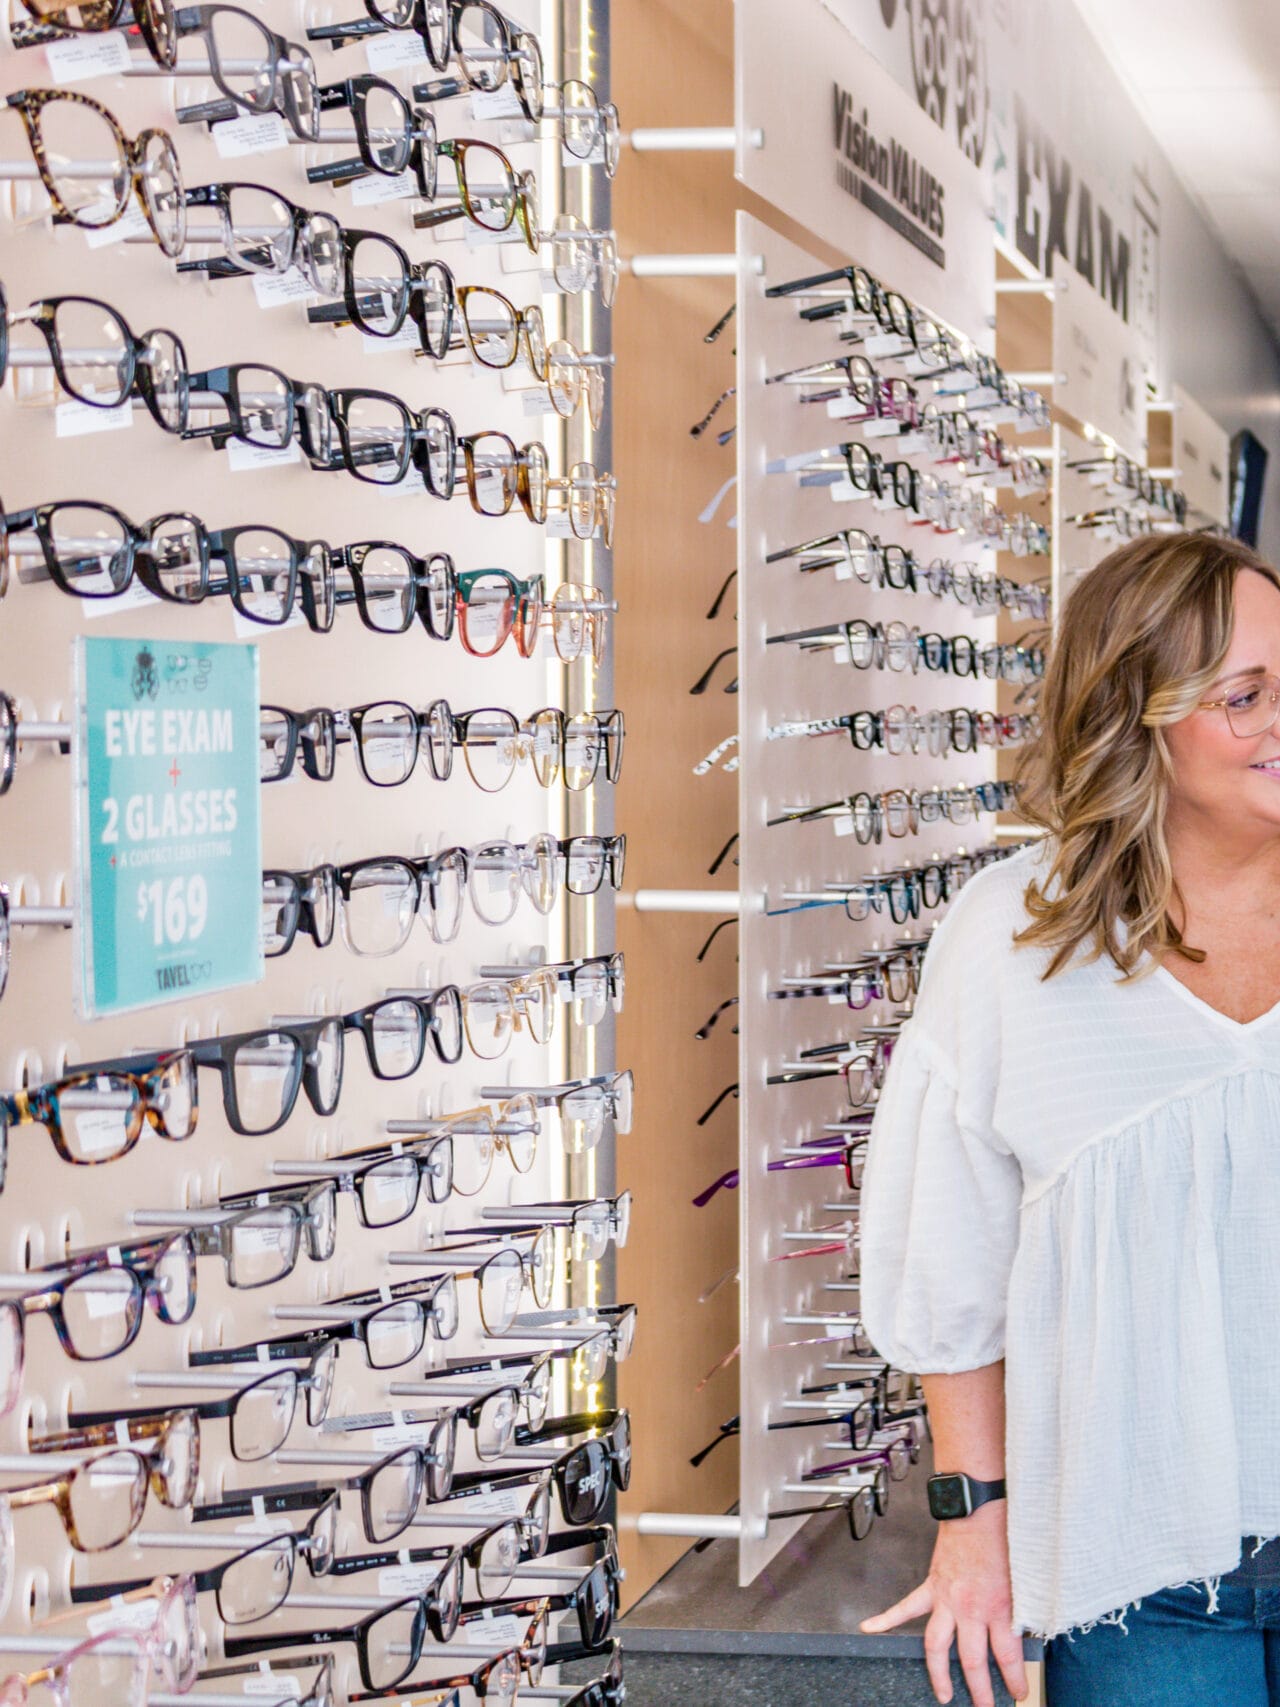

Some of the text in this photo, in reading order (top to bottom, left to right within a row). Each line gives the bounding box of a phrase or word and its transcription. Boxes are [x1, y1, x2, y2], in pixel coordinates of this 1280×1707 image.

[105, 709, 233, 757] EYE EXAM
[101, 787, 238, 844] 2 GLASSES
[137, 873, 209, 946] $169
[156, 964, 191, 990] TAVEL
